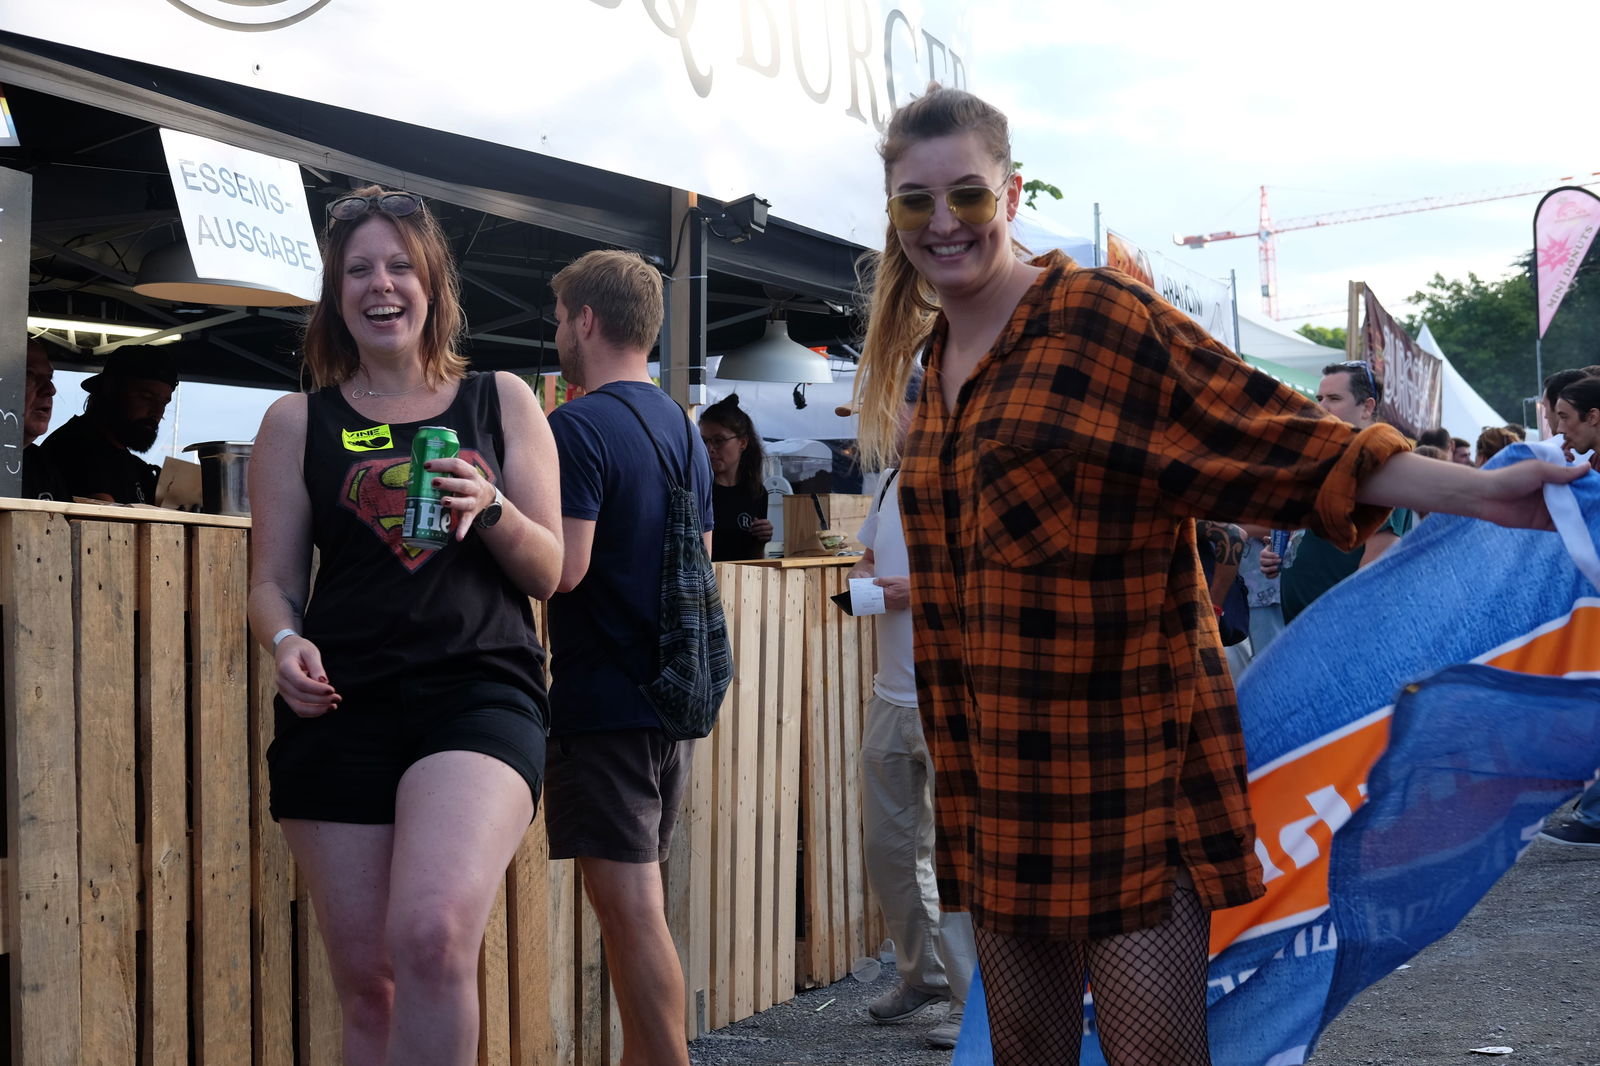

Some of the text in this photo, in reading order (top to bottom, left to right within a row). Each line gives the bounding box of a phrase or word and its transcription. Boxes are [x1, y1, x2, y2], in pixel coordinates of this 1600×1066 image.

[178, 159, 294, 215] ESSENS-
[198, 214, 316, 271] AUSGABE
[1546, 280, 1566, 309] MINI
[1563, 224, 1593, 277] DONUTS
